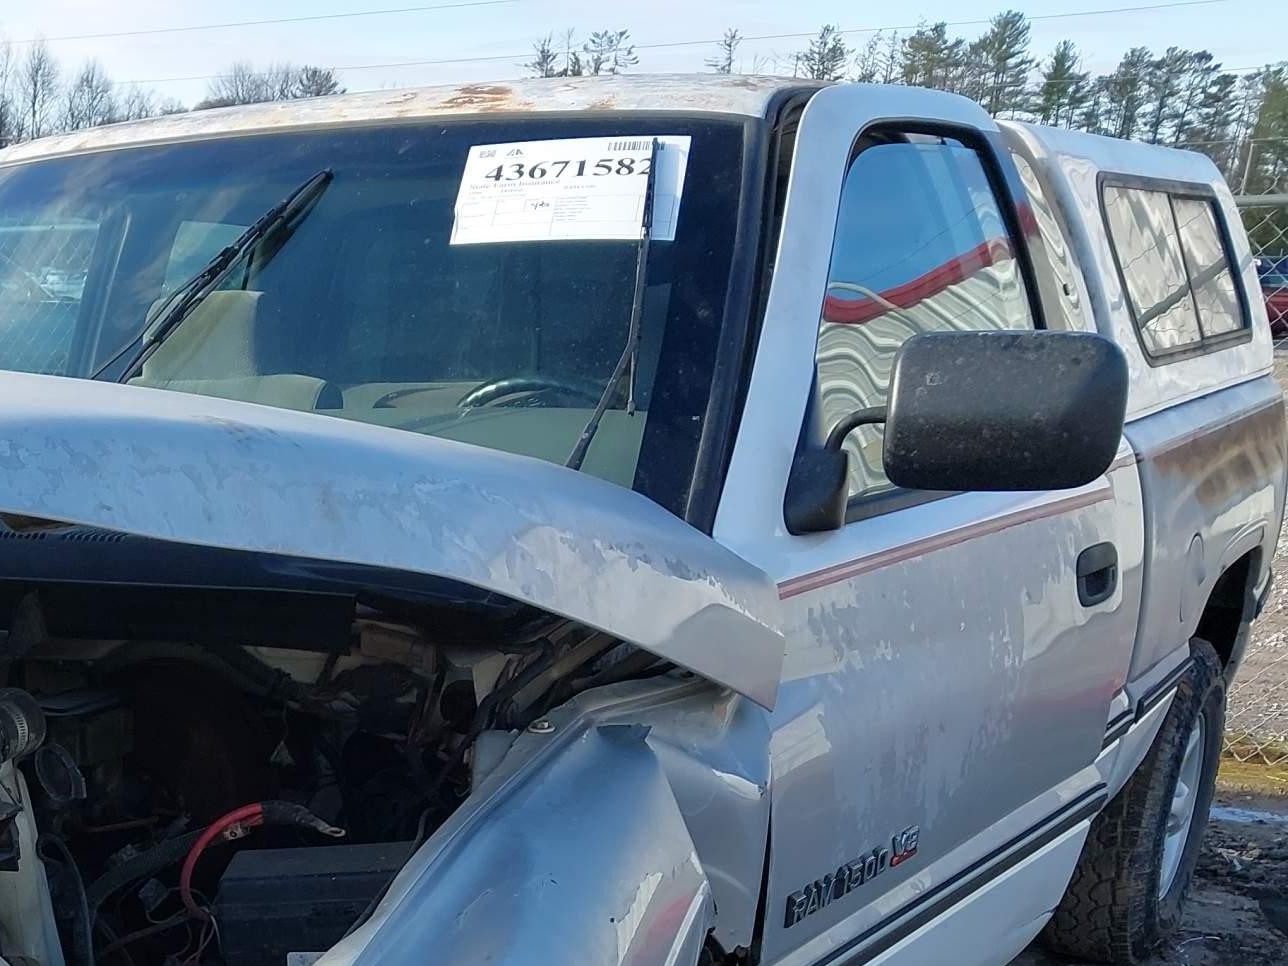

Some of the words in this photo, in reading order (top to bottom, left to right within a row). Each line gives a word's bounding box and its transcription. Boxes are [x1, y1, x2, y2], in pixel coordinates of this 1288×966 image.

[485, 157, 652, 182] 43671582
[784, 873, 837, 928] RAM
[834, 847, 889, 898] 1500
